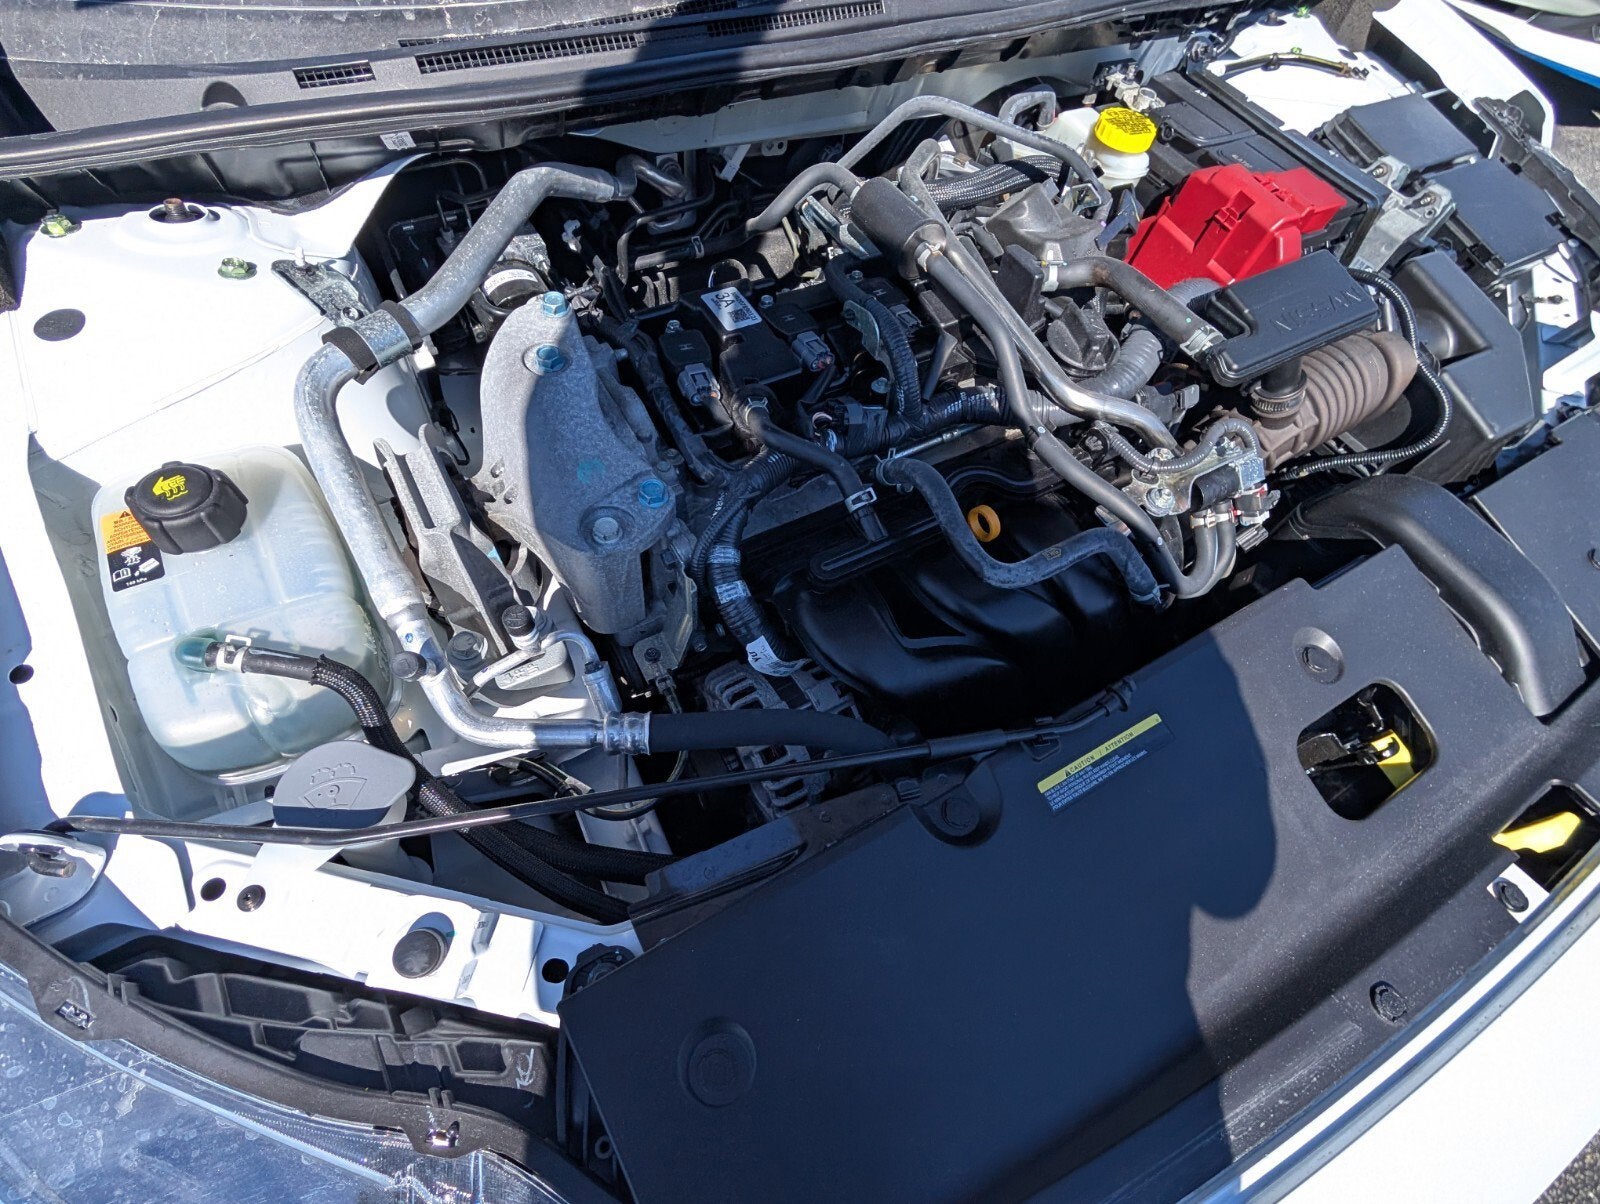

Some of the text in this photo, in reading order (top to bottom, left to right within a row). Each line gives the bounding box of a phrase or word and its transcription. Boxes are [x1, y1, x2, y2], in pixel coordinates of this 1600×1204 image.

[715, 292, 735, 308] 3A
[1069, 755, 1096, 773] CAUTION
[1105, 731, 1135, 753] ATTENTION
